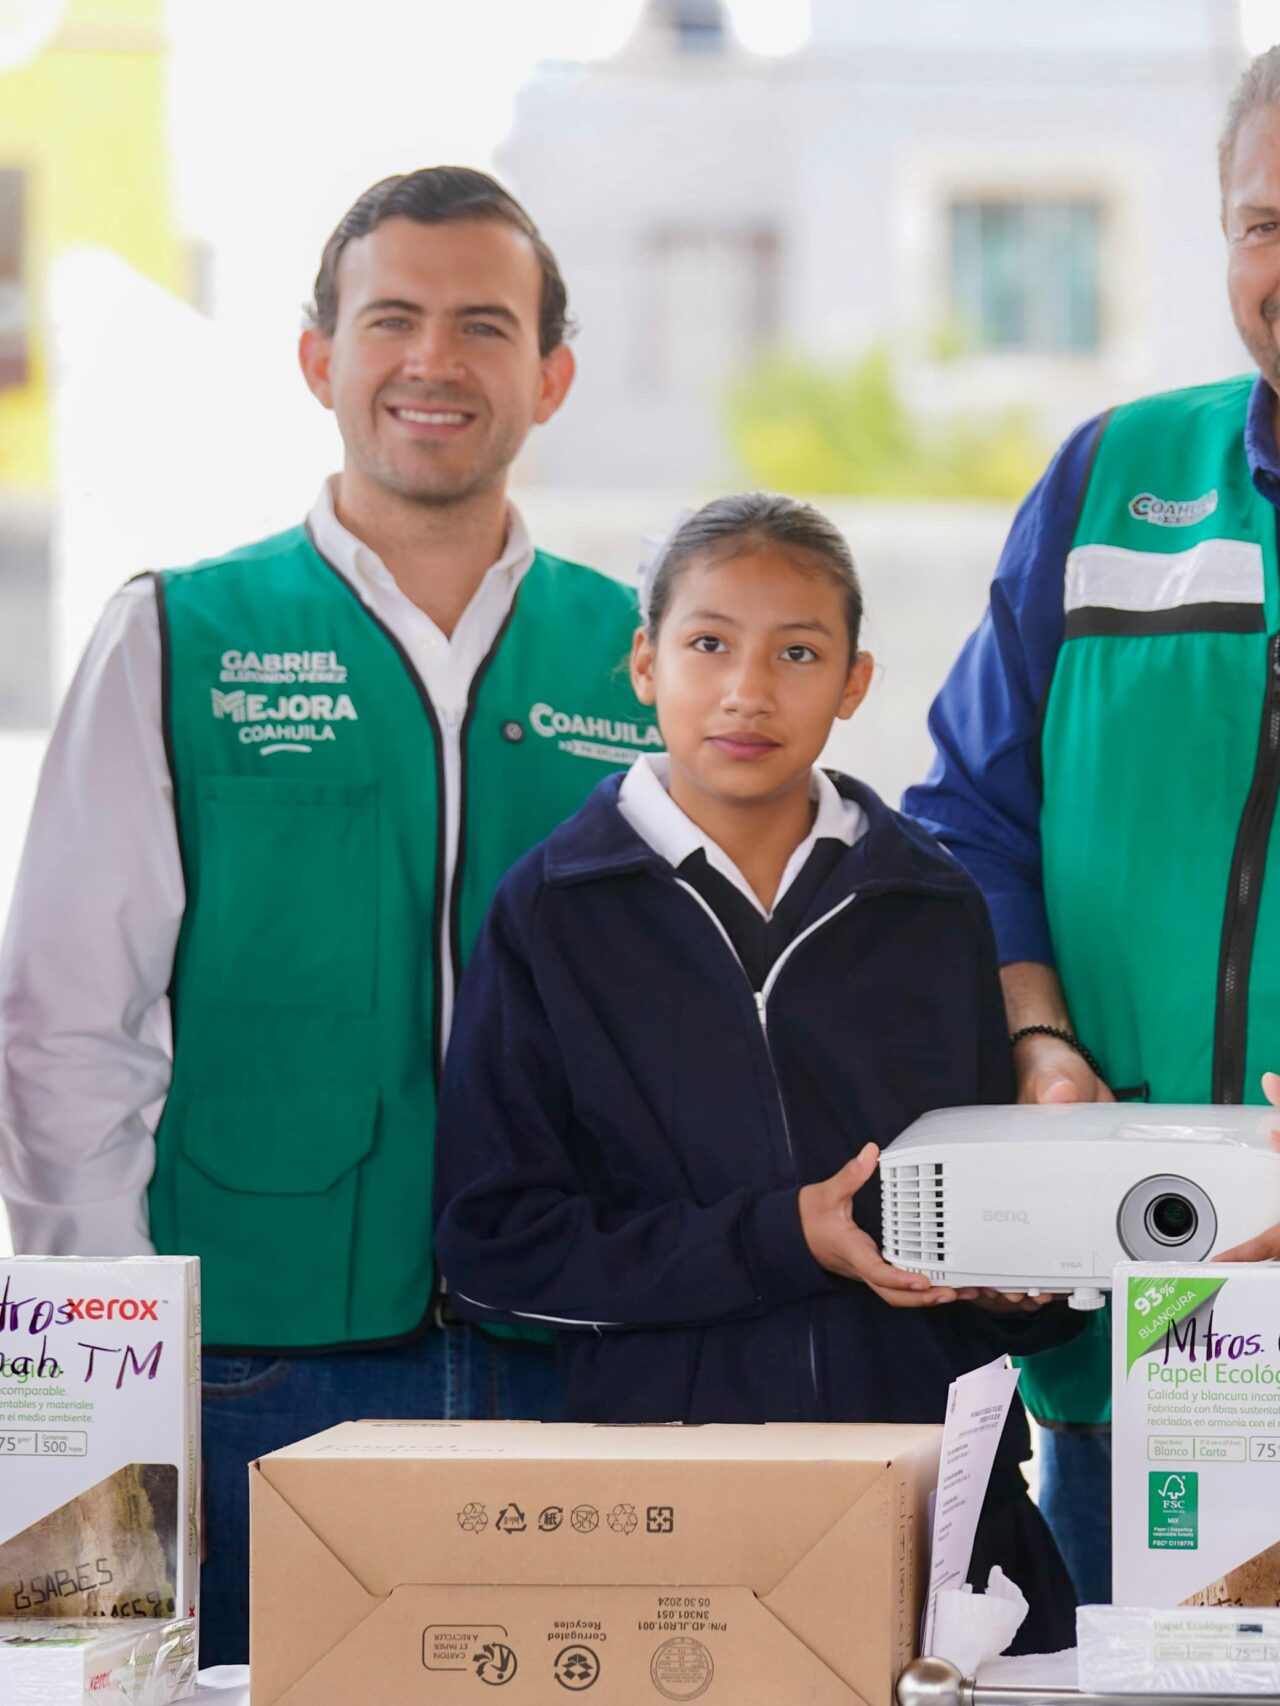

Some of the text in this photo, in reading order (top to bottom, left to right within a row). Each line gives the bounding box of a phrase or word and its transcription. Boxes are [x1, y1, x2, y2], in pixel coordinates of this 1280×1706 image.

[221, 650, 347, 672] GABRIEL
[210, 687, 358, 723] MEJORA
[529, 702, 667, 747] COAHUILA
[239, 723, 336, 744] COAHUILA
[982, 1209, 1031, 1225] BenQ
[1134, 1284, 1175, 1317] 93%
[66, 1298, 158, 1321] xerox
[1138, 1290, 1197, 1340] BLANCURA
[1147, 1362, 1208, 1388] Papel
[1147, 1389, 1189, 1401] Calidad
[1191, 1392, 1199, 1403] y
[1201, 1390, 1248, 1401] blancura
[46, 1401, 95, 1409] materiales
[1147, 1404, 1192, 1414] Fabricado
[1194, 1406, 1211, 1414] con
[1213, 1404, 1238, 1414] fibras
[18, 1413, 47, 1422] medio
[1147, 1417, 1192, 1427] reciclados
[1194, 1419, 1206, 1427] en
[1248, 1420, 1265, 1428] con
[1267, 1418, 1276, 1427] el
[43, 1441, 67, 1453] 500
[1154, 1446, 1189, 1457] Blanco
[1200, 1446, 1227, 1457] Carta
[1256, 1443, 1276, 1458] 75
[1163, 1500, 1185, 1509] FSC
[658, 1597, 711, 1607] 05 30 2024
[657, 1610, 710, 1620] 3N301.051
[554, 1621, 601, 1630] Recycles
[708, 1622, 727, 1631] P/N:
[434, 1634, 471, 1642] RECYCLER
[548, 1631, 607, 1642] Corrugated
[433, 1652, 466, 1660] CARTON
